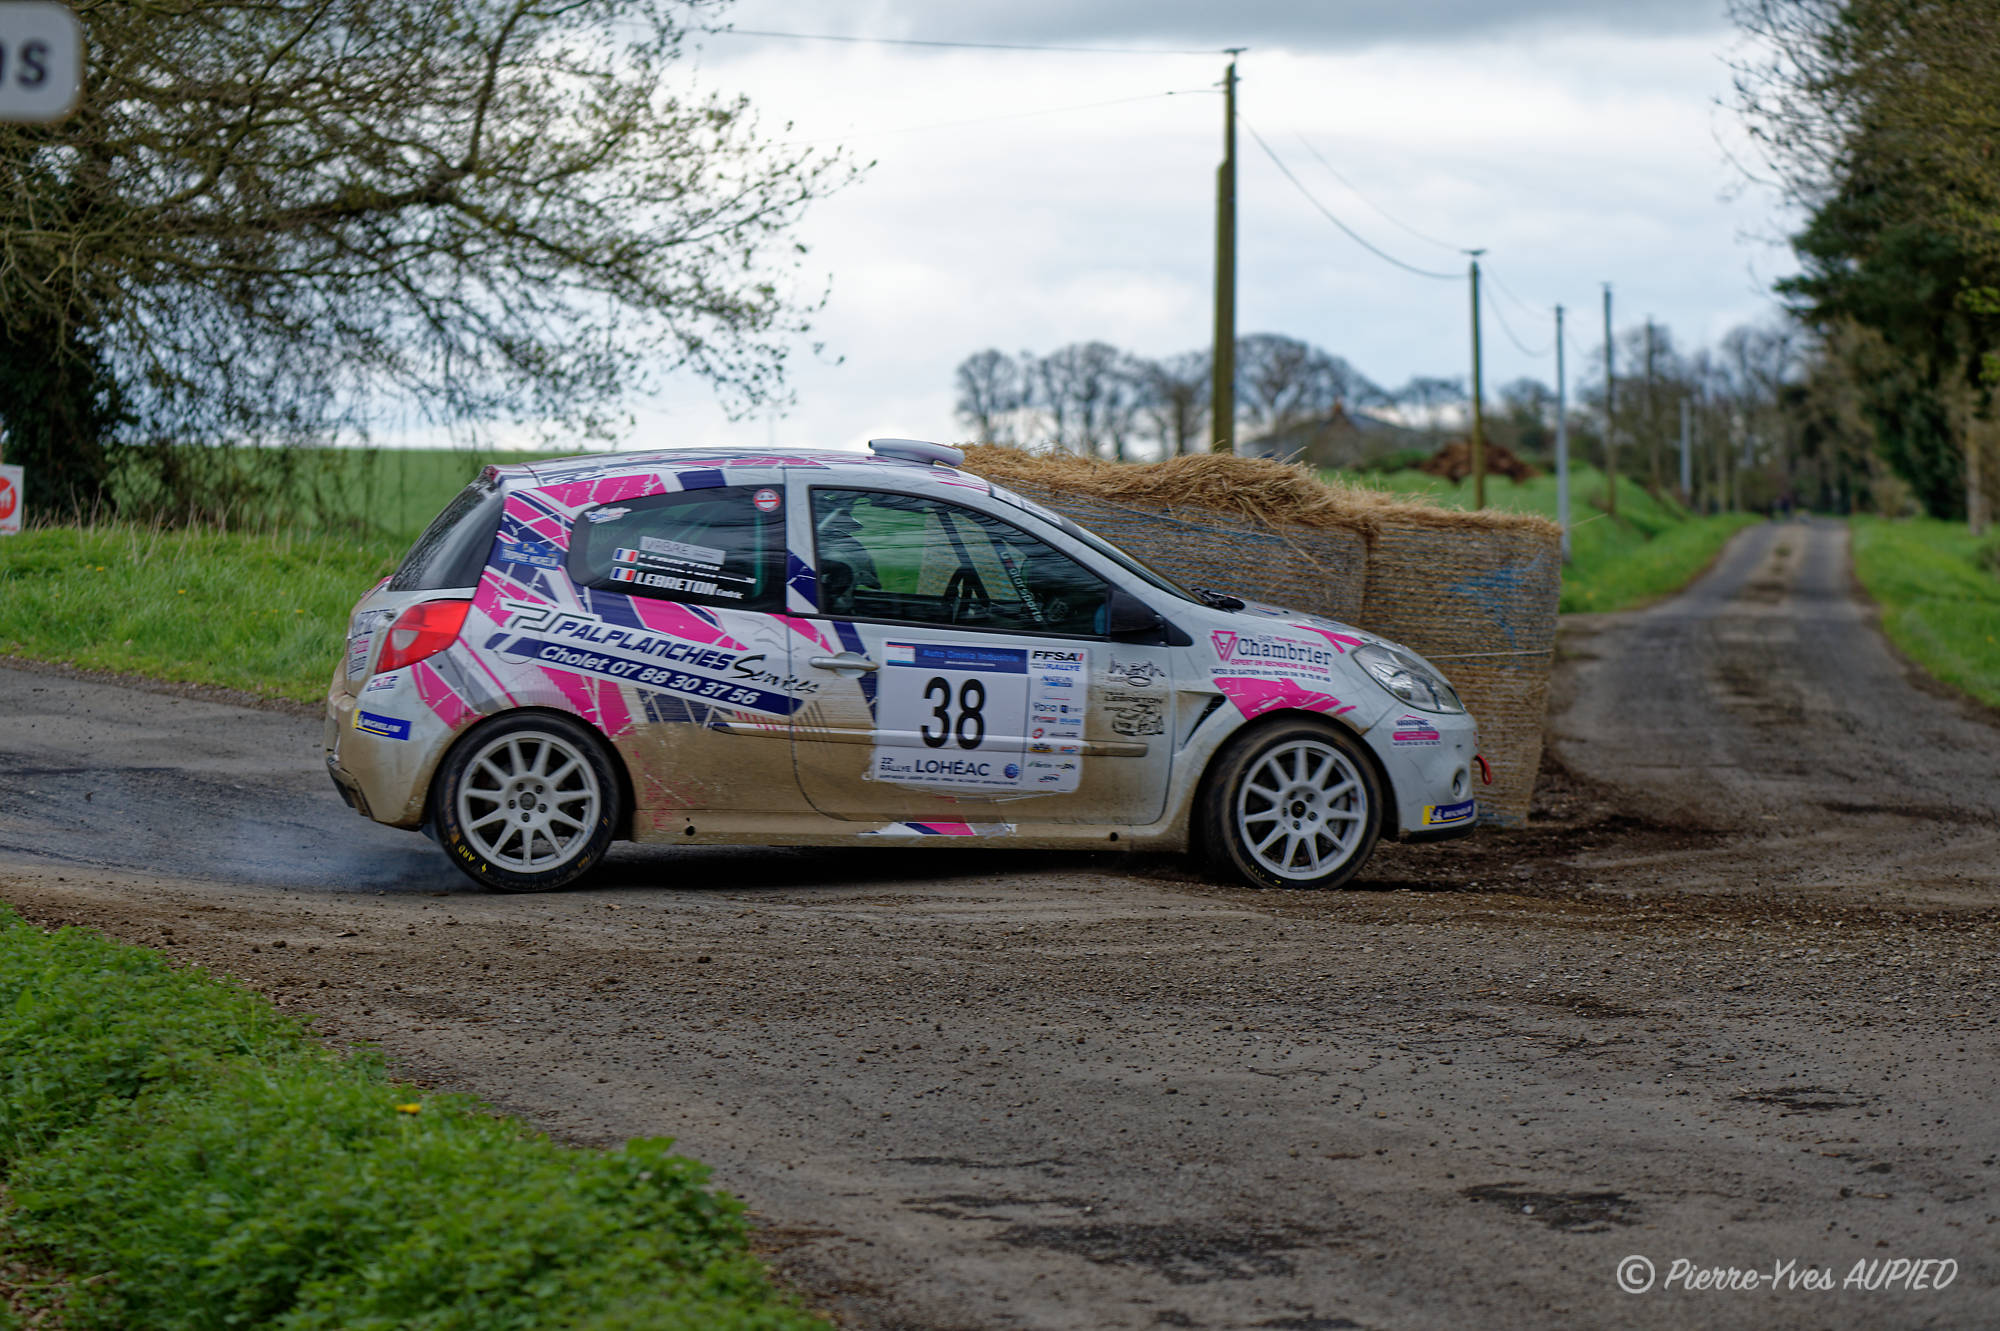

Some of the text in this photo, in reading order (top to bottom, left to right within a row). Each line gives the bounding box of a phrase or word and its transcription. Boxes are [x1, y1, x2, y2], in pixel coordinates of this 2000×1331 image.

[634, 572, 718, 596] LEBRETON
[553, 620, 736, 671] PALPLANCHES
[1032, 650, 1077, 661] FFSA
[1238, 638, 1332, 665] Chambrier
[540, 645, 761, 705] Cholet 07 88 30 37 56
[921, 676, 985, 749] 38
[915, 759, 990, 776] LOHÉAC
